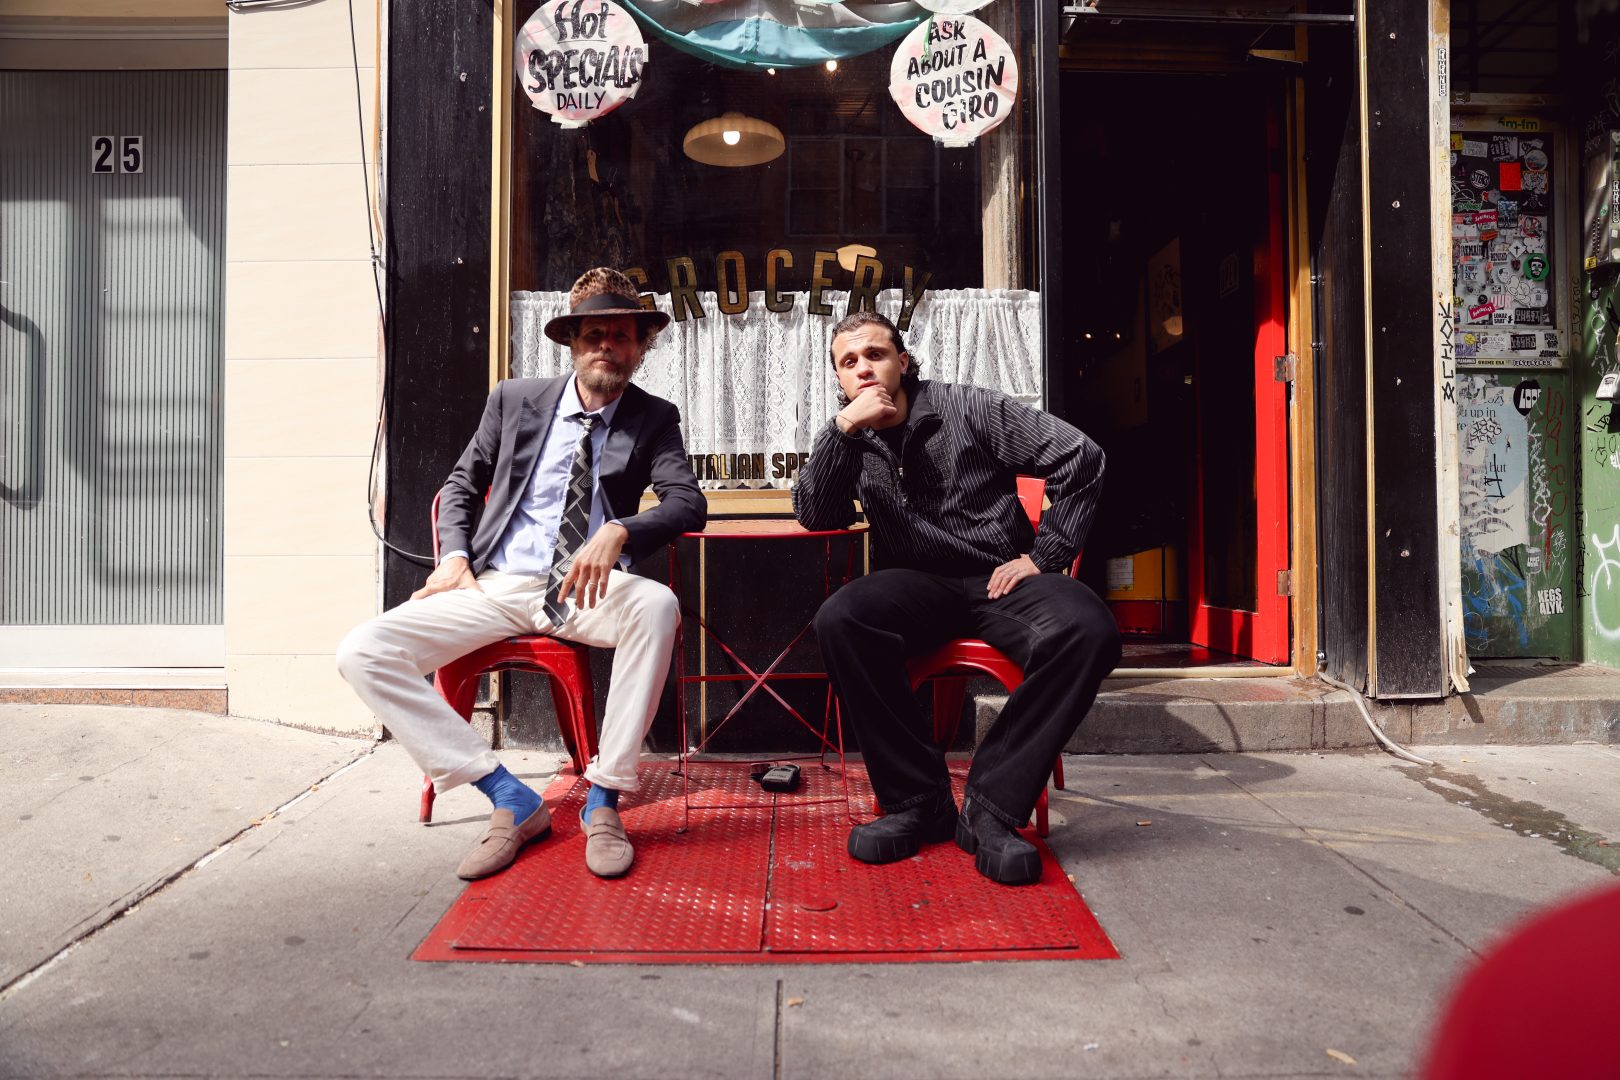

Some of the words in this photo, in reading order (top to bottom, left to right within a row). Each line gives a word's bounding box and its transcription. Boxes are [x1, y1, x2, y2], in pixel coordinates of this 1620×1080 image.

[555, 0, 616, 40] Hot
[929, 20, 966, 45] ASK
[528, 45, 644, 94] SPECIALS
[907, 44, 967, 80] ABOUT
[973, 38, 987, 62] A
[915, 56, 1005, 108] COUSIN
[556, 91, 606, 111] DAILY
[94, 137, 141, 172] 25
[626, 249, 934, 331] GROCERY
[1470, 409, 1484, 418] up
[1486, 407, 1496, 417] in
[688, 453, 765, 480] ITALIAN
[1489, 462, 1506, 473] but
